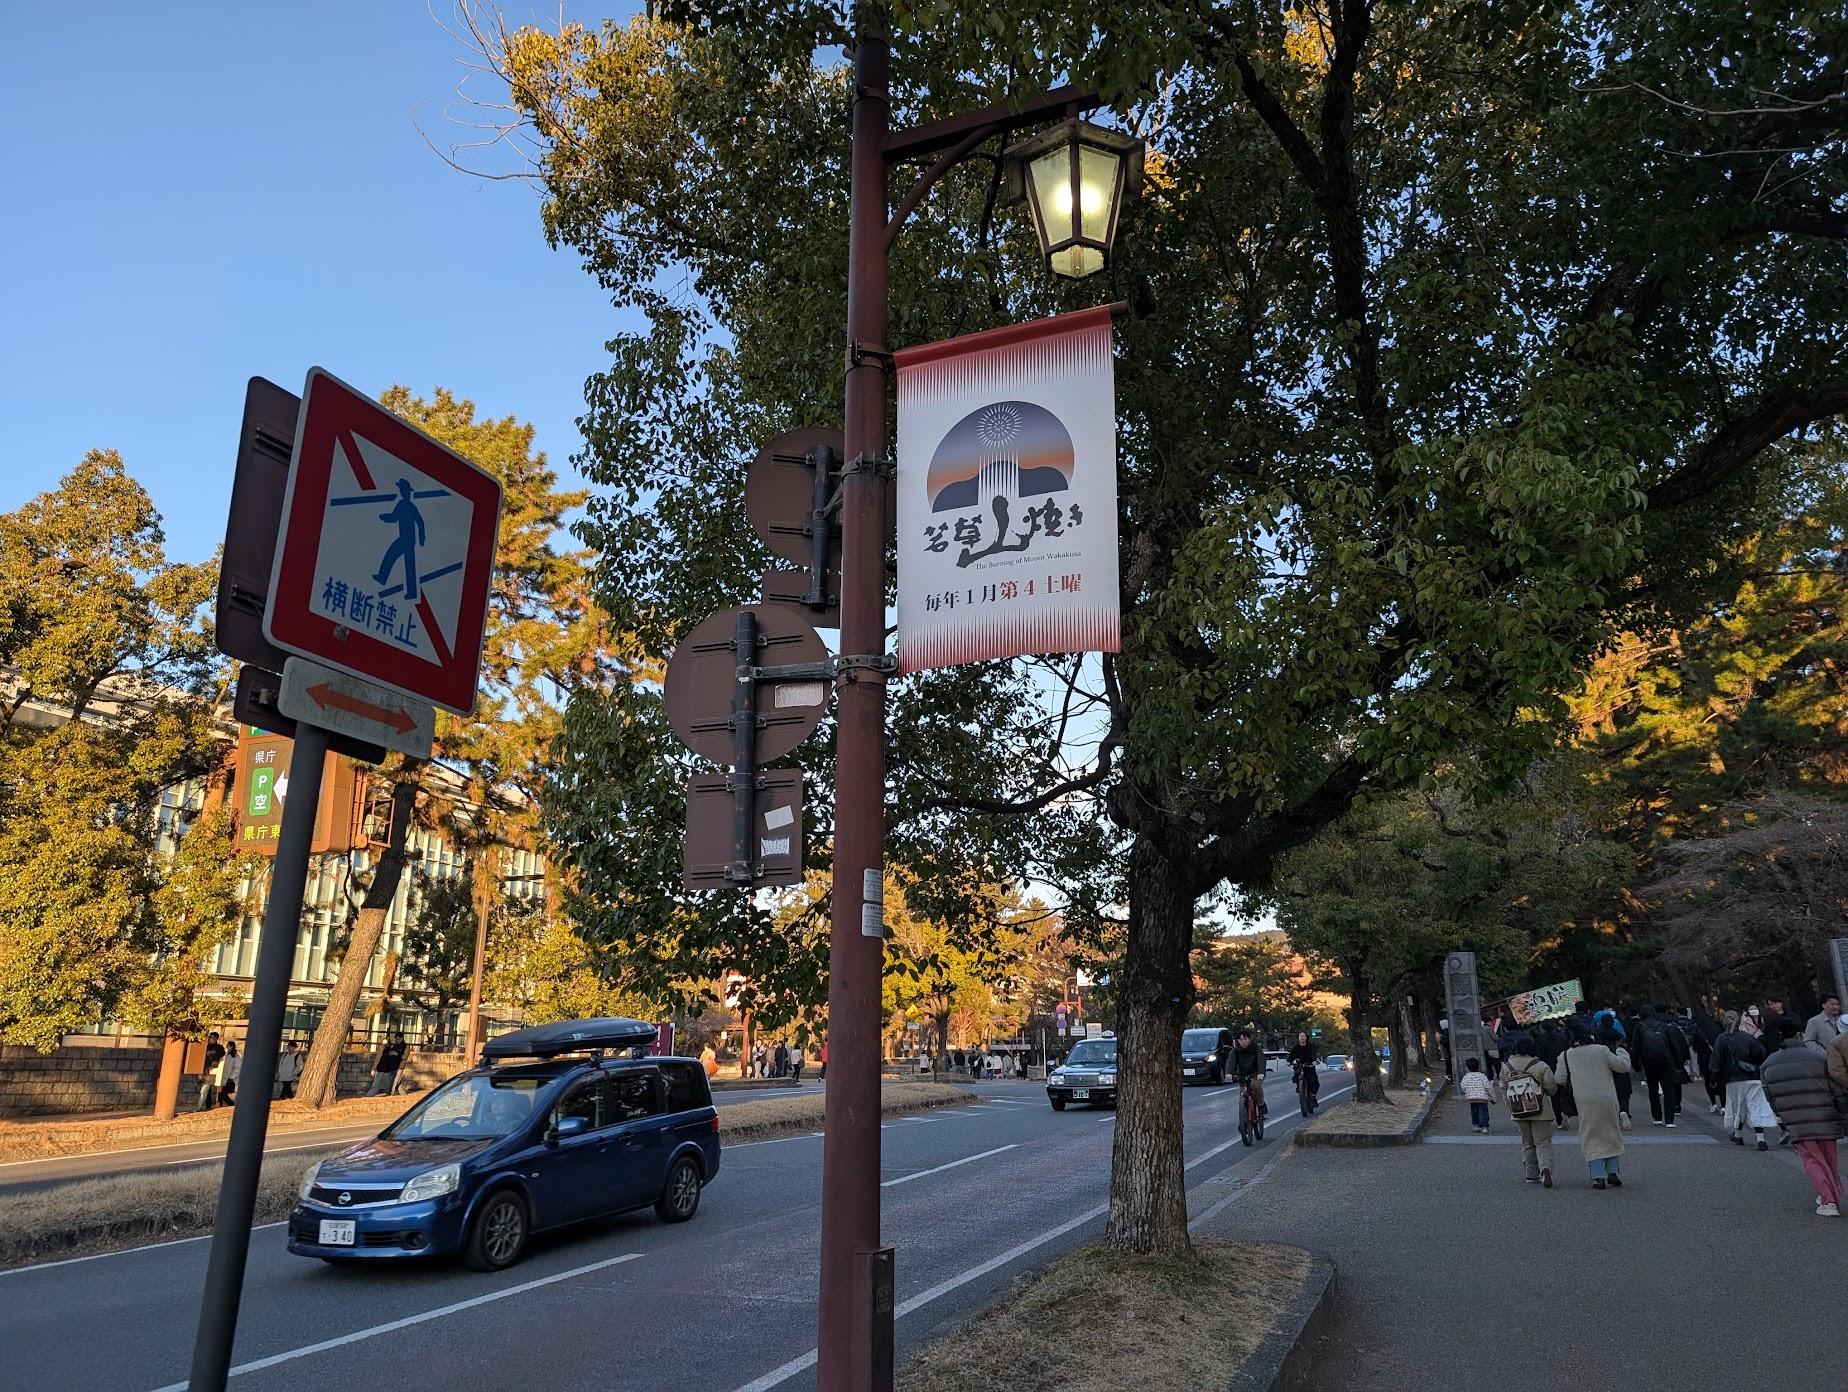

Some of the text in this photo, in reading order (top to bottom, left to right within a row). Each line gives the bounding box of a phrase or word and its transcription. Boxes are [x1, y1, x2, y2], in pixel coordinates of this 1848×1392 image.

[922, 495, 1084, 569] 若草山焼き
[988, 559, 1014, 568] Burning
[1023, 555, 1045, 563] Mount
[1046, 551, 1082, 560] Wakakusa
[322, 575, 418, 649] 横断禁止
[254, 750, 277, 764] 県庁
